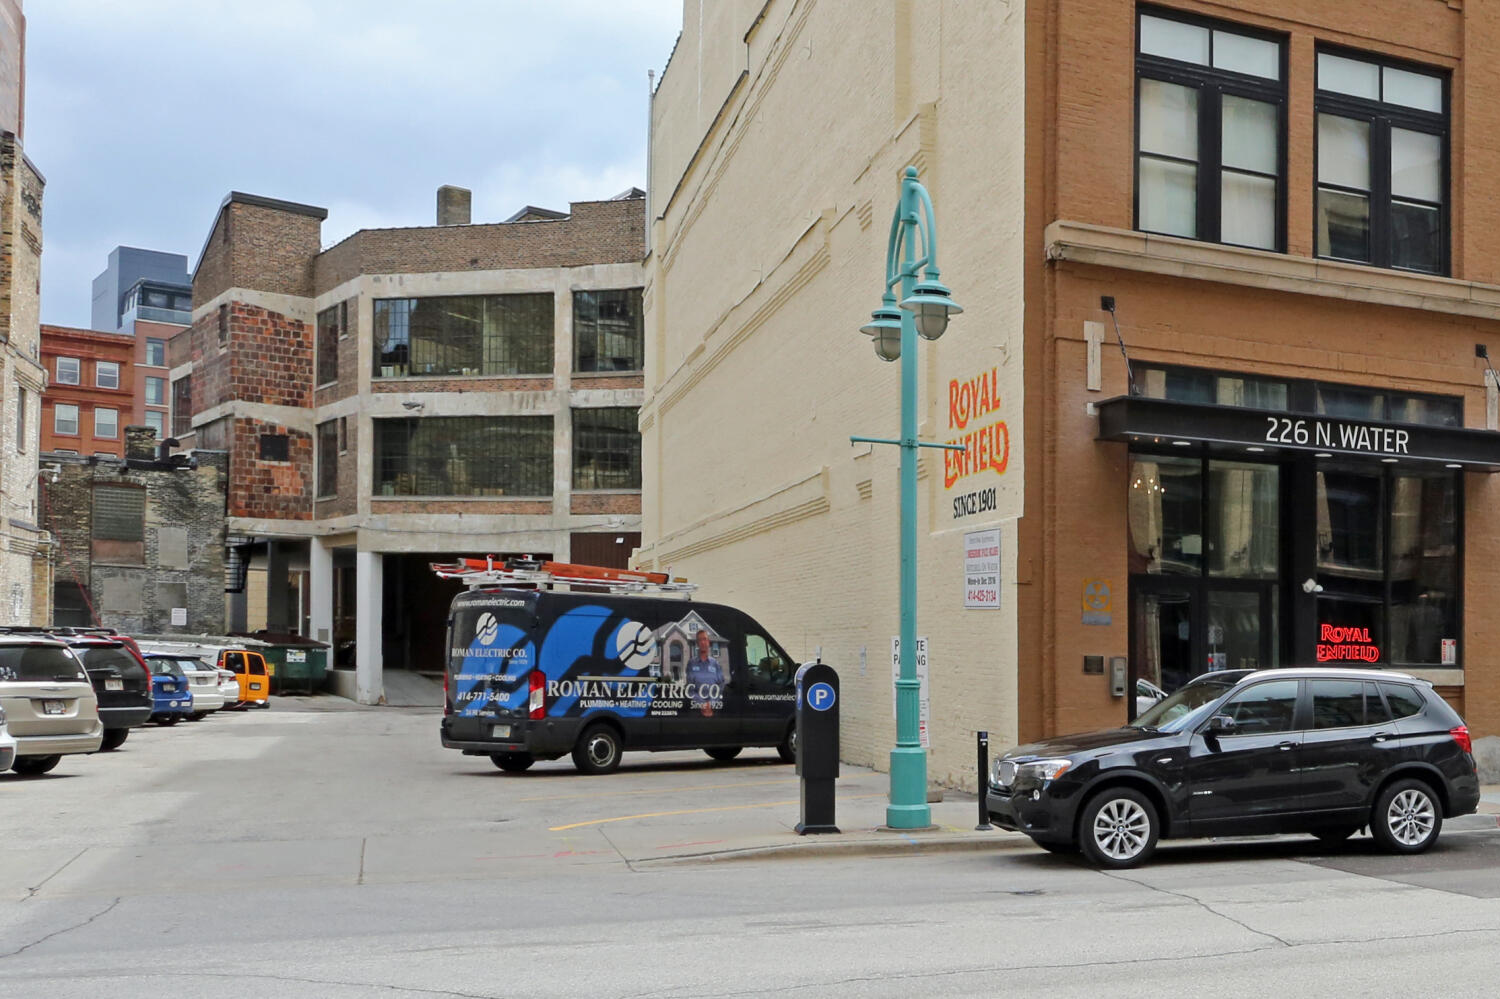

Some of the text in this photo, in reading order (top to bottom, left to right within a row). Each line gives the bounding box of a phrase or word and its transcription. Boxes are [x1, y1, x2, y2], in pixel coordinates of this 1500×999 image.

[949, 366, 1001, 430] ROYAL
[1266, 417, 1409, 454] 226 N. WATER
[944, 420, 1010, 490] ENFIELD
[953, 488, 997, 519] SINCE 1901
[1321, 624, 1372, 643] ROYAL
[475, 648, 512, 658] ELECTRIC
[512, 649, 528, 659] CO.
[1316, 644, 1380, 663] ENFIELD
[547, 680, 724, 700] ROMAN ELECTRIC CO.
[815, 689, 828, 705] P
[580, 699, 684, 709] PLUMBING HEATING COOLING
